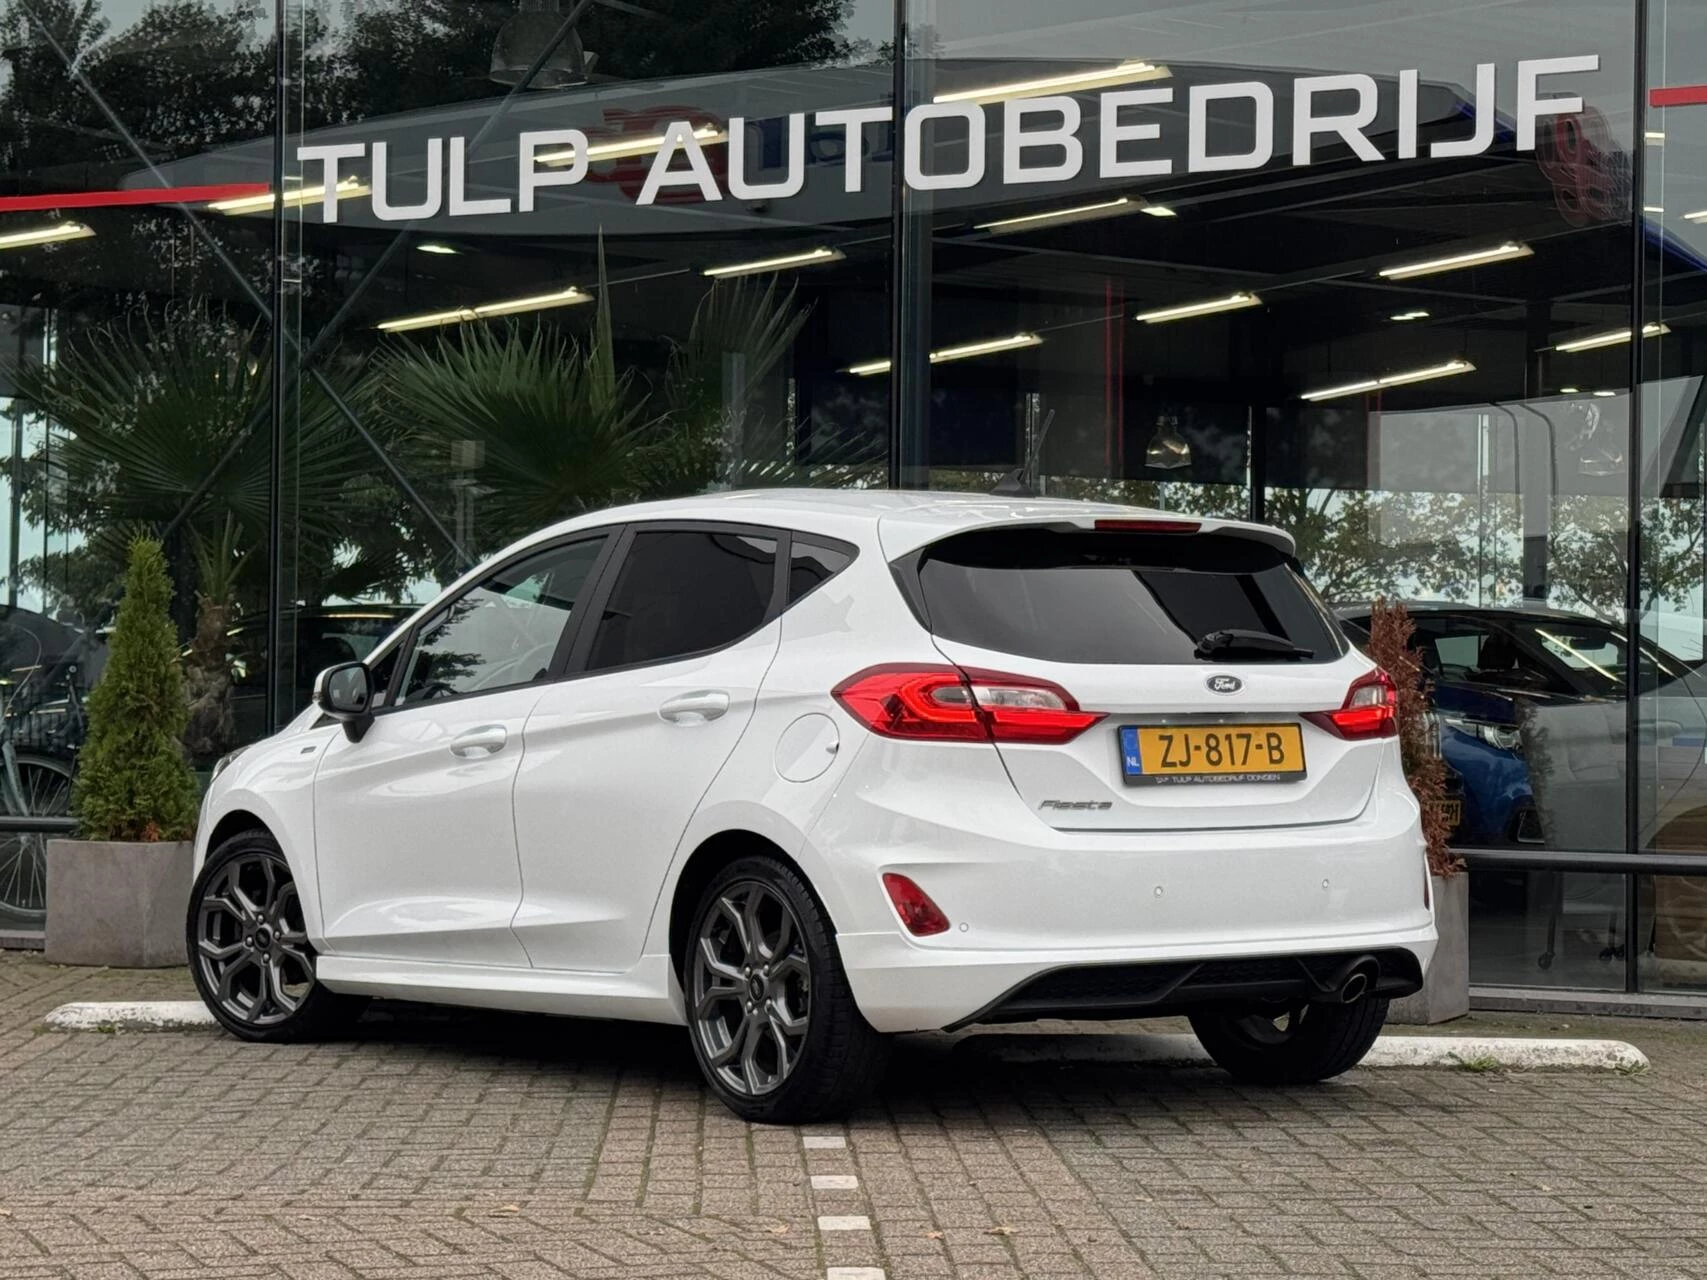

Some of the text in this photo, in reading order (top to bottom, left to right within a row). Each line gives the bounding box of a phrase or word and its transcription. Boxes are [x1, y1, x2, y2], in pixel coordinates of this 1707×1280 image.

[297, 54, 1599, 224] TULP AUTOBEDRIJF
[1126, 756, 1140, 767] NL
[1158, 732, 1285, 768] ZJ-817-B
